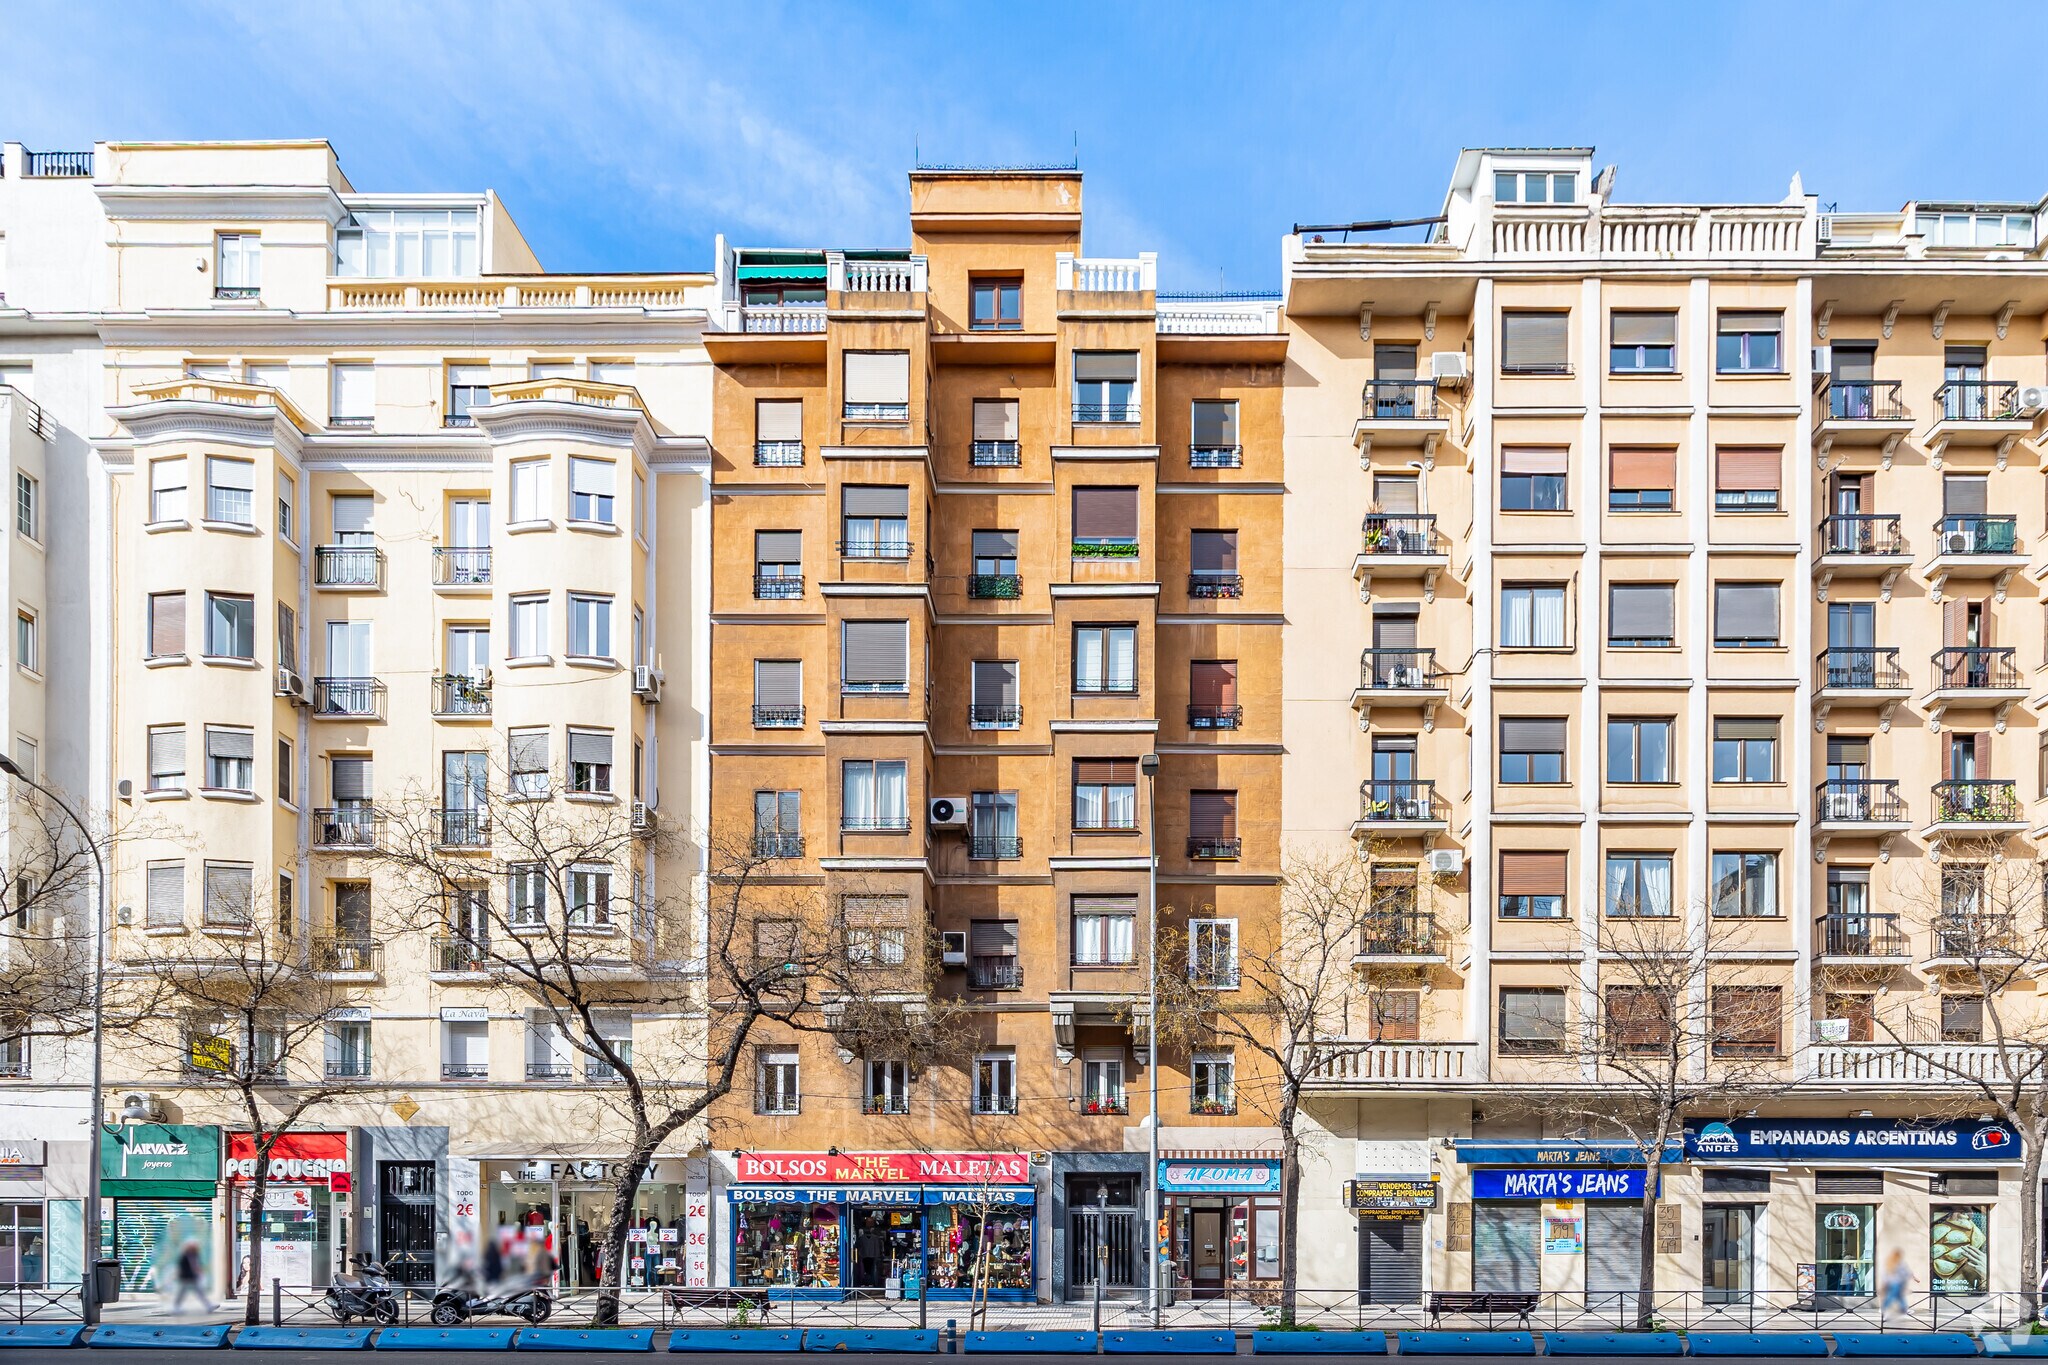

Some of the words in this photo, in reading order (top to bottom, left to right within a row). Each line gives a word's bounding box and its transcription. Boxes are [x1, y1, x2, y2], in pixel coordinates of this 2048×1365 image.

[444, 1010, 456, 1018] La
[1750, 1129, 1850, 1145] EMPANADAS
[1855, 1129, 1958, 1145] ARGENTINAS
[121, 1126, 189, 1177] NARVAEZ
[1697, 1144, 1739, 1152] ANDES
[854, 1156, 890, 1168] THE
[1537, 1151, 1570, 1162] MARTA'S
[1575, 1151, 1601, 1162] JEANS
[141, 1160, 173, 1170] joyeros
[745, 1159, 827, 1176] BOLSOS
[918, 1160, 1021, 1176] MALETAS
[518, 1170, 537, 1180] THE
[550, 1163, 659, 1180] FACTOY
[835, 1168, 910, 1180] MARVEL
[1183, 1167, 1254, 1181] AROMA
[1378, 1182, 1412, 1190] VENDEMOS
[1504, 1172, 1572, 1195] MARTA'S
[1576, 1173, 1630, 1194] JEANS
[733, 1190, 796, 1200] BOLSOS
[807, 1190, 837, 1201] THE
[846, 1190, 914, 1201] MARVEL
[942, 1191, 1016, 1202] MALETAS
[1356, 1189, 1393, 1197] COMPRAMOS
[456, 1204, 474, 1216] 2€
[689, 1205, 706, 1217] 2€
[1658, 1206, 1675, 1220] 35
[1658, 1222, 1675, 1237] 39
[689, 1233, 706, 1245] 3€
[694, 1261, 704, 1270] 5€
[688, 1278, 705, 1287] 10€
